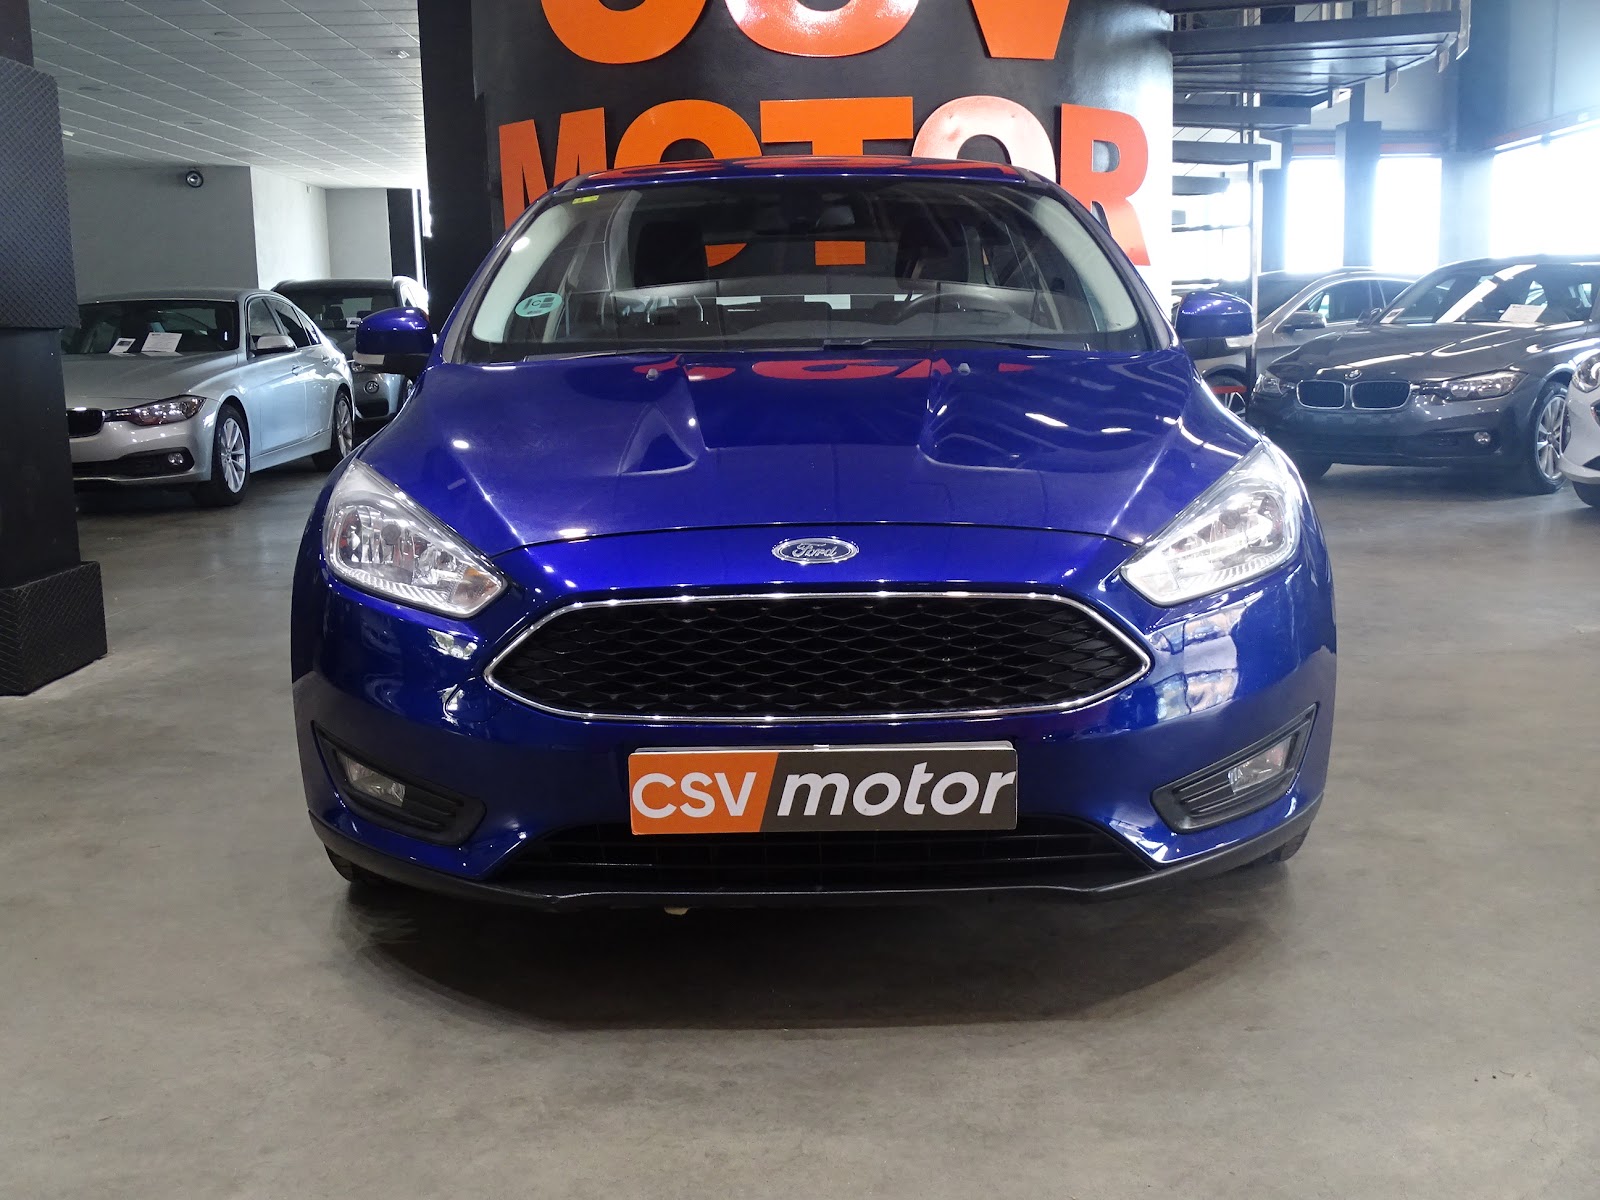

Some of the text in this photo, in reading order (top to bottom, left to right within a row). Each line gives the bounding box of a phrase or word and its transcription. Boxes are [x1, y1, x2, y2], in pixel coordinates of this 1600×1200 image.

[792, 543, 838, 557] Ford
[631, 762, 1016, 818] CSV motor
